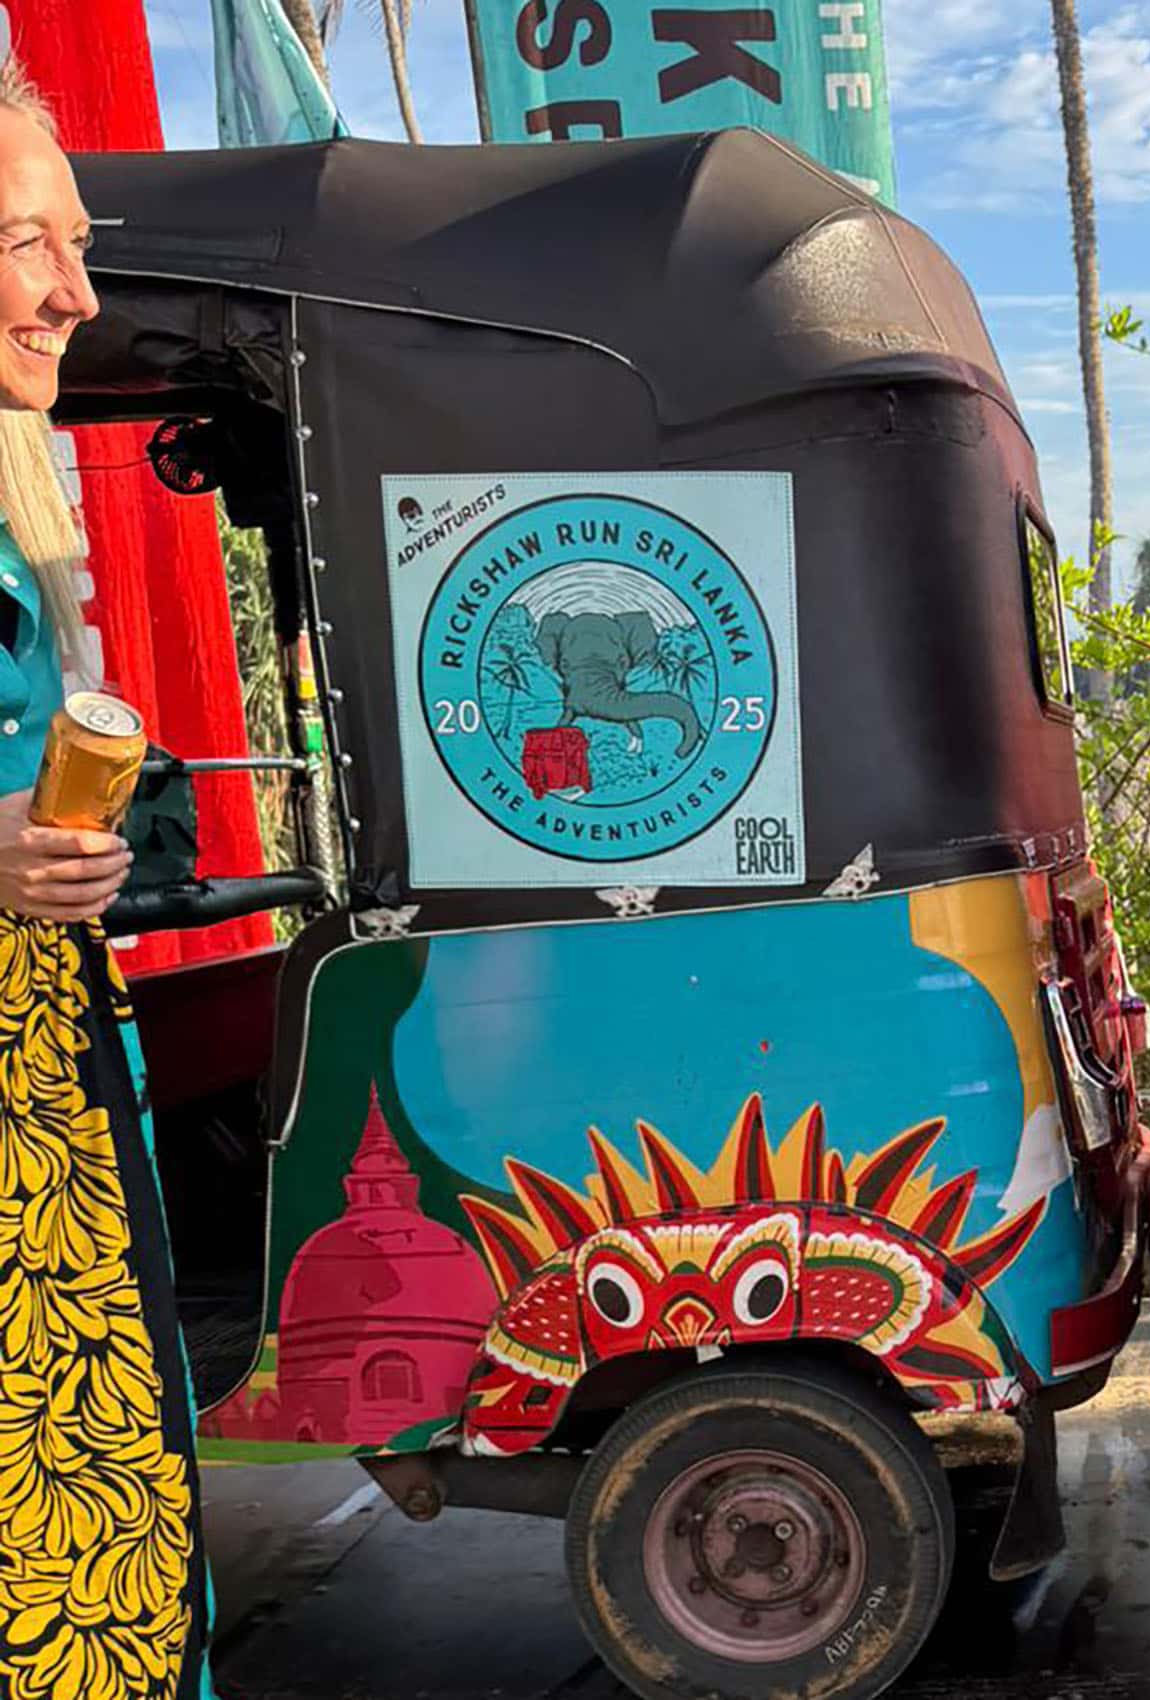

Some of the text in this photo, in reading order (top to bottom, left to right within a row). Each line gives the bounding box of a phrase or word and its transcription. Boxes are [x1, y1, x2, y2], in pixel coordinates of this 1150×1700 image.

[397, 484, 507, 568] ADVENTURISTS
[432, 499, 453, 520] THE
[440, 521, 754, 669] RICKSHAW RUN SRI LANKA
[434, 700, 481, 734] 20
[720, 698, 765, 732] 25
[480, 767, 728, 840] THE ADVENTURISTS
[735, 818, 795, 841] COOL
[736, 840, 796, 875] EARTH
